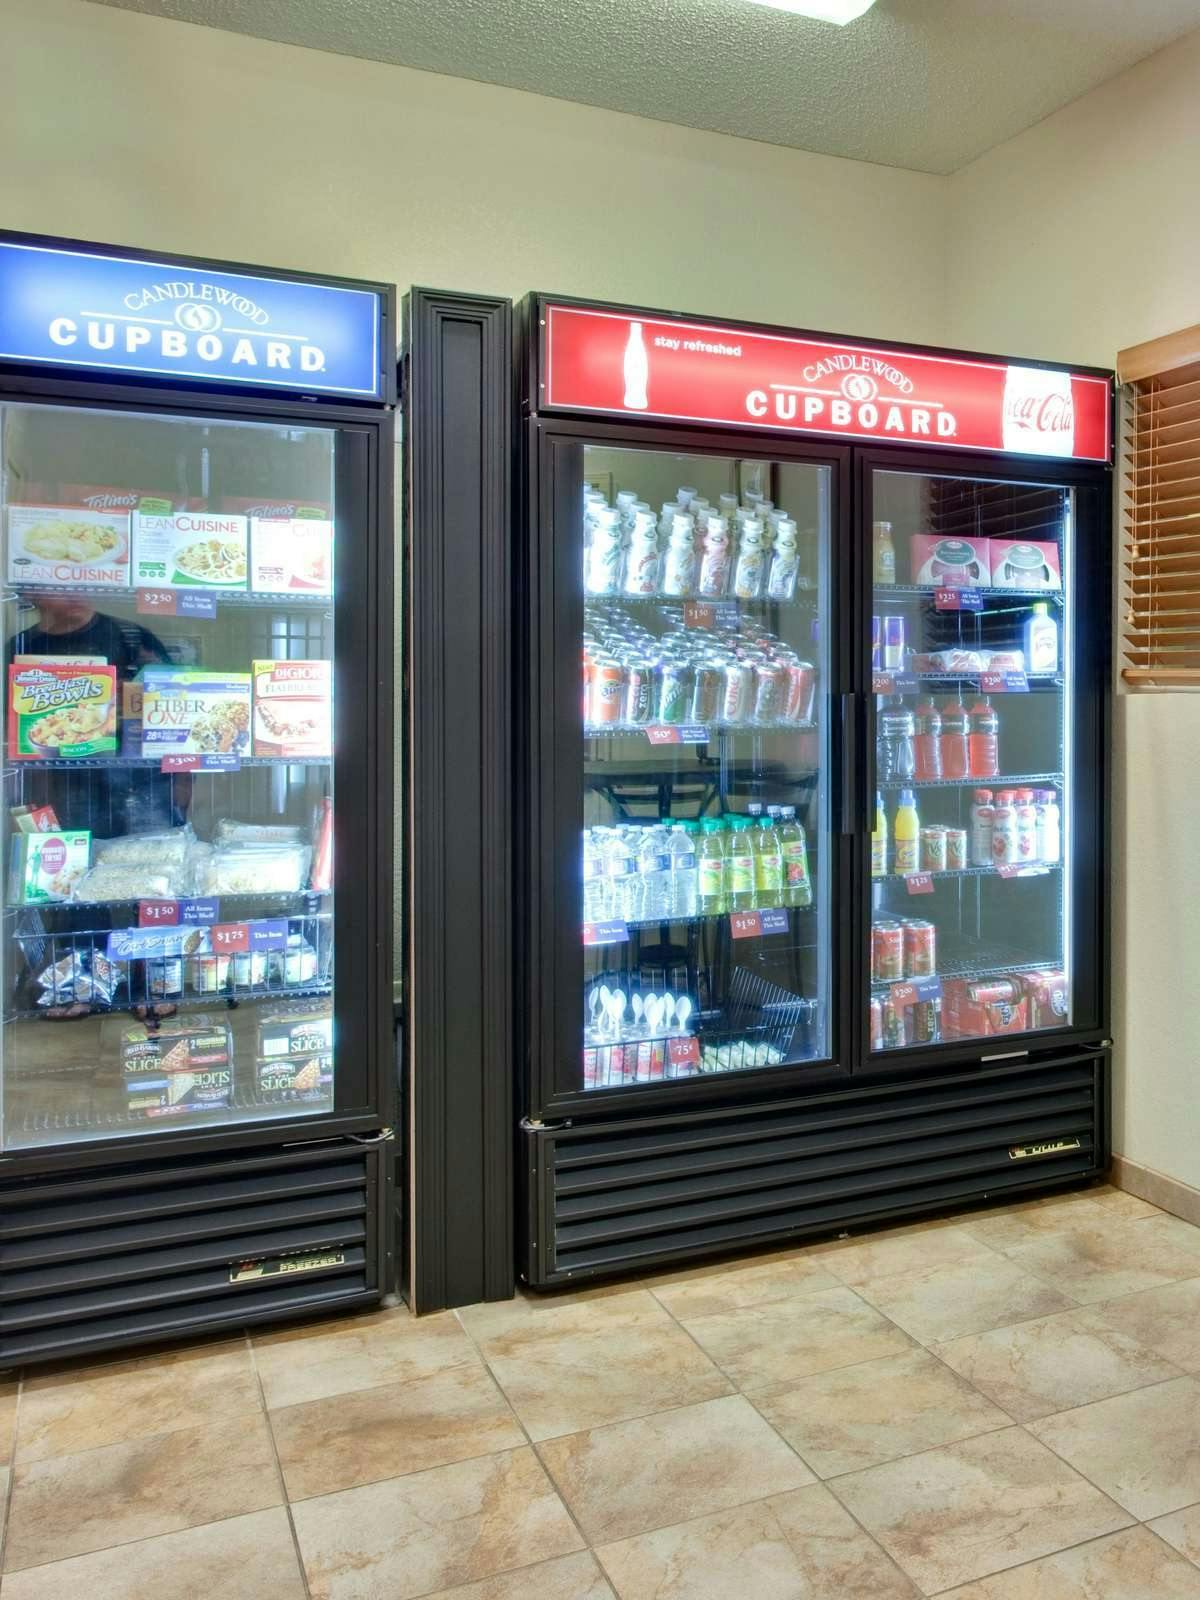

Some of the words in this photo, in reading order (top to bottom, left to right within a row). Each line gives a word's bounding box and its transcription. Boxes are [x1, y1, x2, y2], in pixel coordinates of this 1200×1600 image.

[124, 282, 269, 326] CANDLEWOOD
[49, 318, 325, 372] CUPBOARD
[655, 336, 680, 350] stay
[683, 340, 742, 357] refreshed
[803, 355, 914, 394] CANDLEWOOD
[746, 390, 957, 437] CUPBOARD
[22, 677, 89, 699] Breakfast
[146, 708, 192, 725] ONE
[154, 700, 208, 713] FIBER
